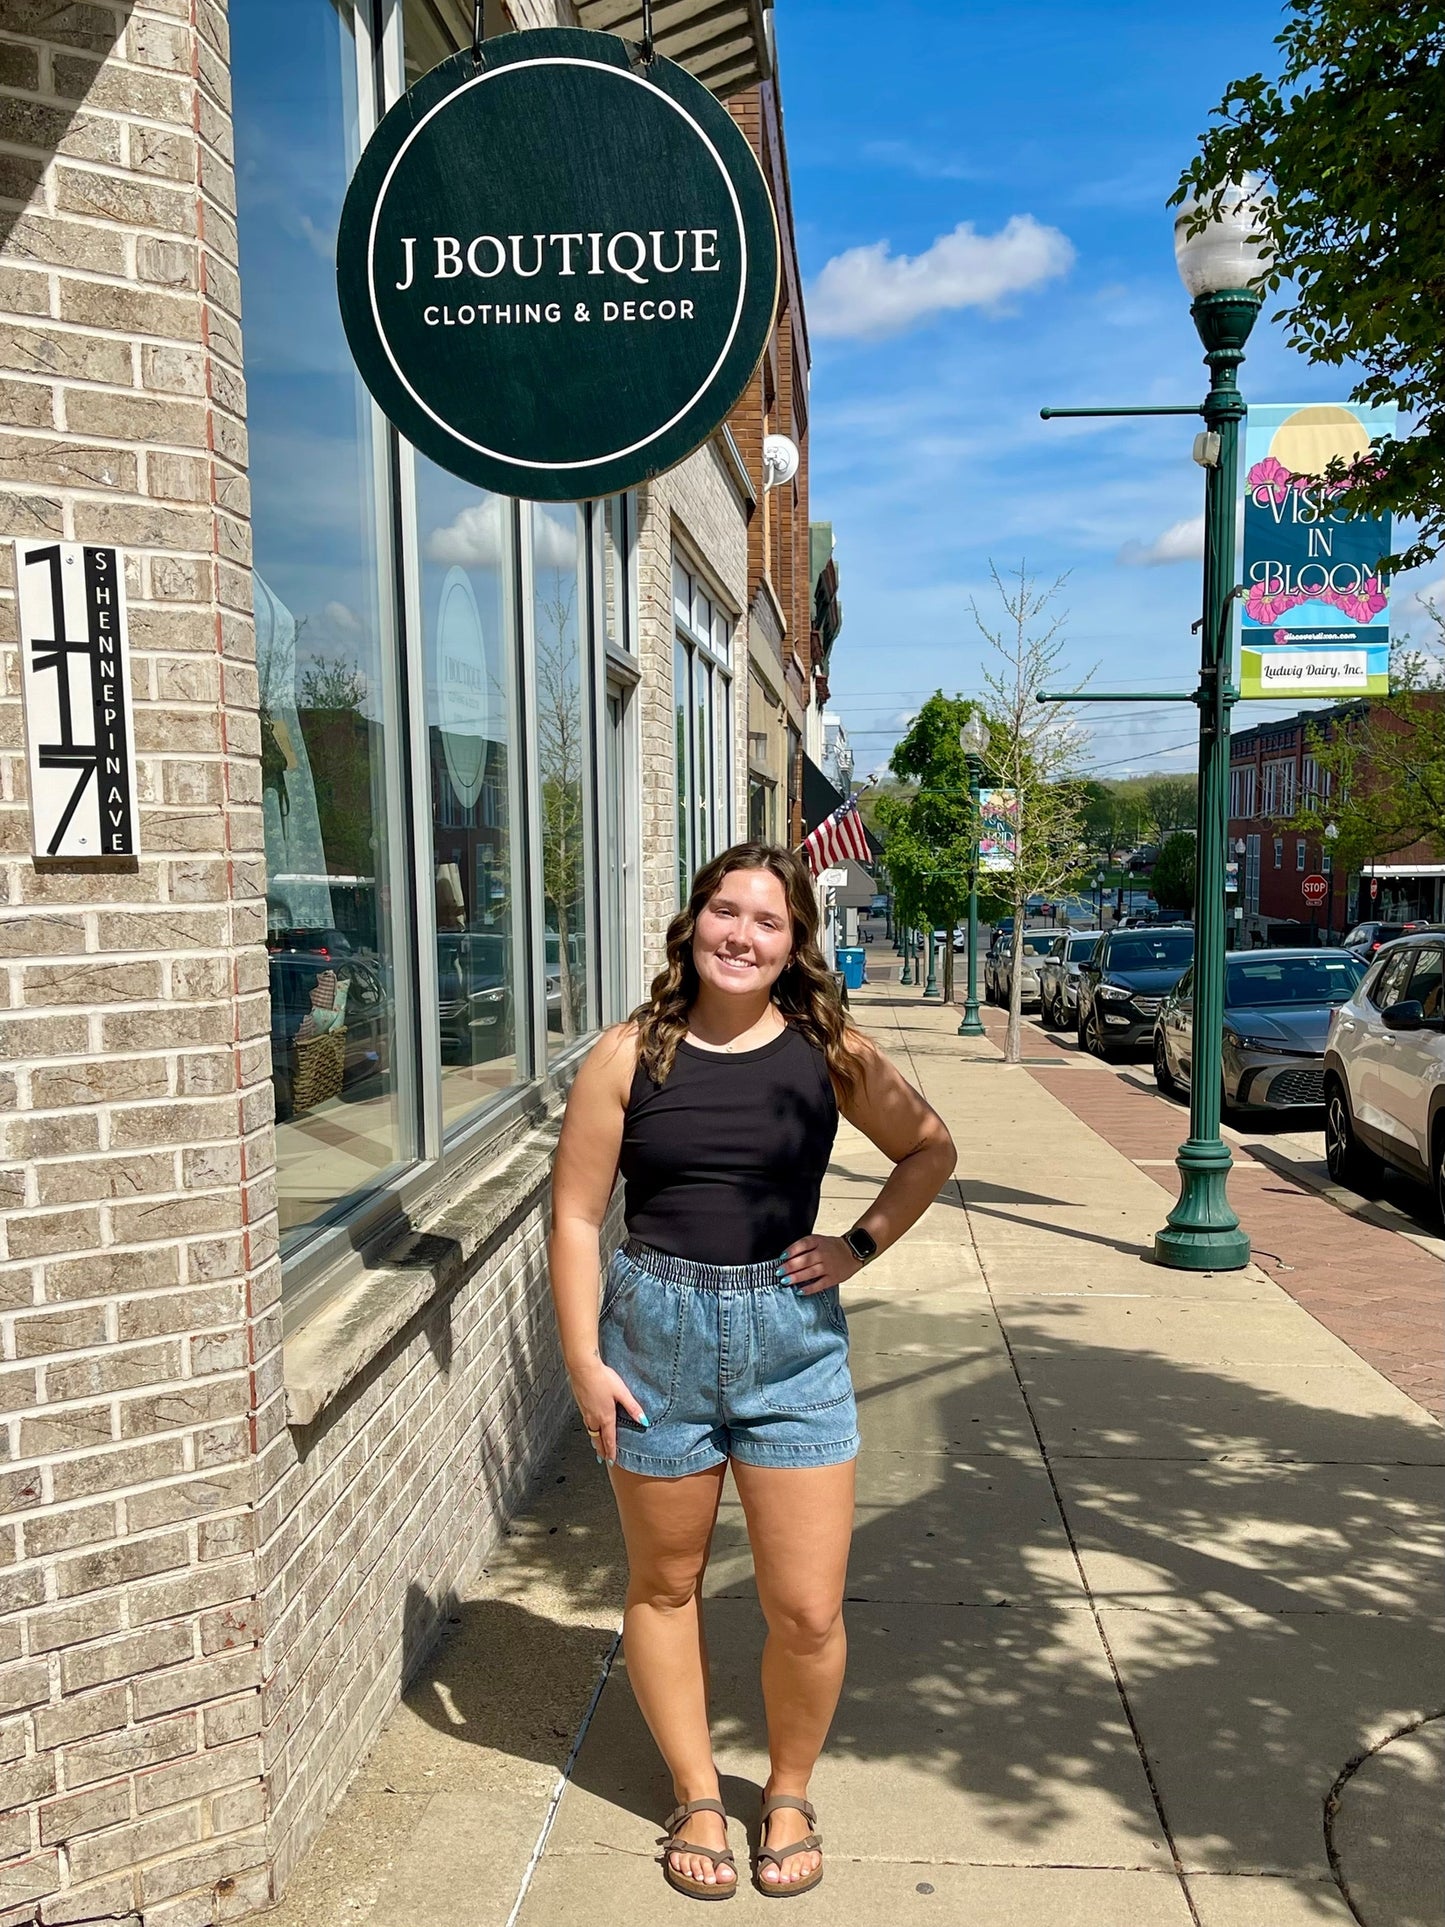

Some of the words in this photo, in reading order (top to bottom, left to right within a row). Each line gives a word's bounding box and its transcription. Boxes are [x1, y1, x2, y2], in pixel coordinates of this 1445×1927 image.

[396, 237, 418, 291] J
[433, 228, 722, 285] BOUTIQUE
[423, 302, 562, 326] CLOTHING
[573, 300, 591, 323] &
[603, 299, 695, 322] DECOR
[1307, 527, 1334, 557] IN
[1249, 560, 1383, 597] BLOOM
[96, 586, 121, 775] HENNEPIN
[1263, 664, 1303, 680] Ludwig
[1305, 663, 1341, 679] Dairy,
[1343, 663, 1364, 676] Inc.
[24, 544, 98, 857] 117
[107, 785, 124, 851] AVE
[1304, 882, 1326, 893] STOP
